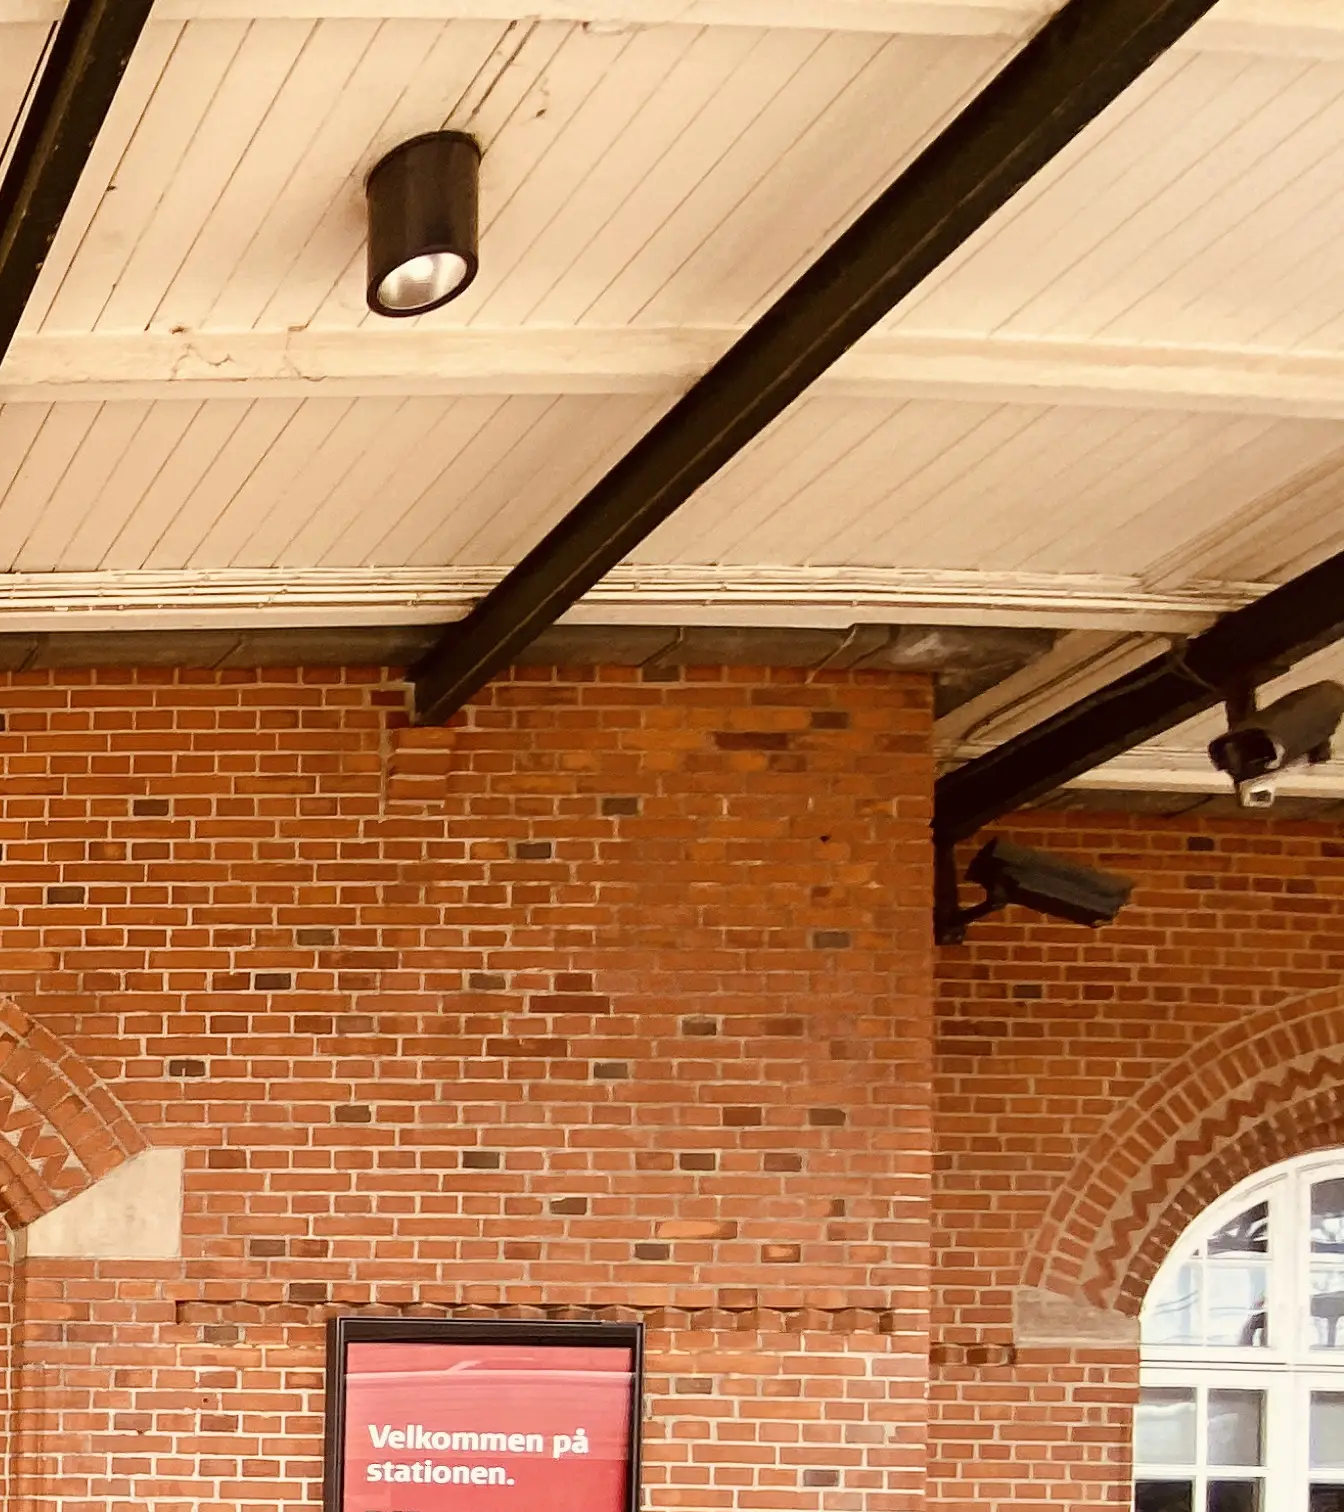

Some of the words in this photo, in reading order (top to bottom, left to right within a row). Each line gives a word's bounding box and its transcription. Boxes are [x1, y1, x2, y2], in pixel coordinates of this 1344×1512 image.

[368, 1424, 544, 1453] Velkommen
[552, 1427, 589, 1459] på
[366, 1459, 515, 1485] stationen.
